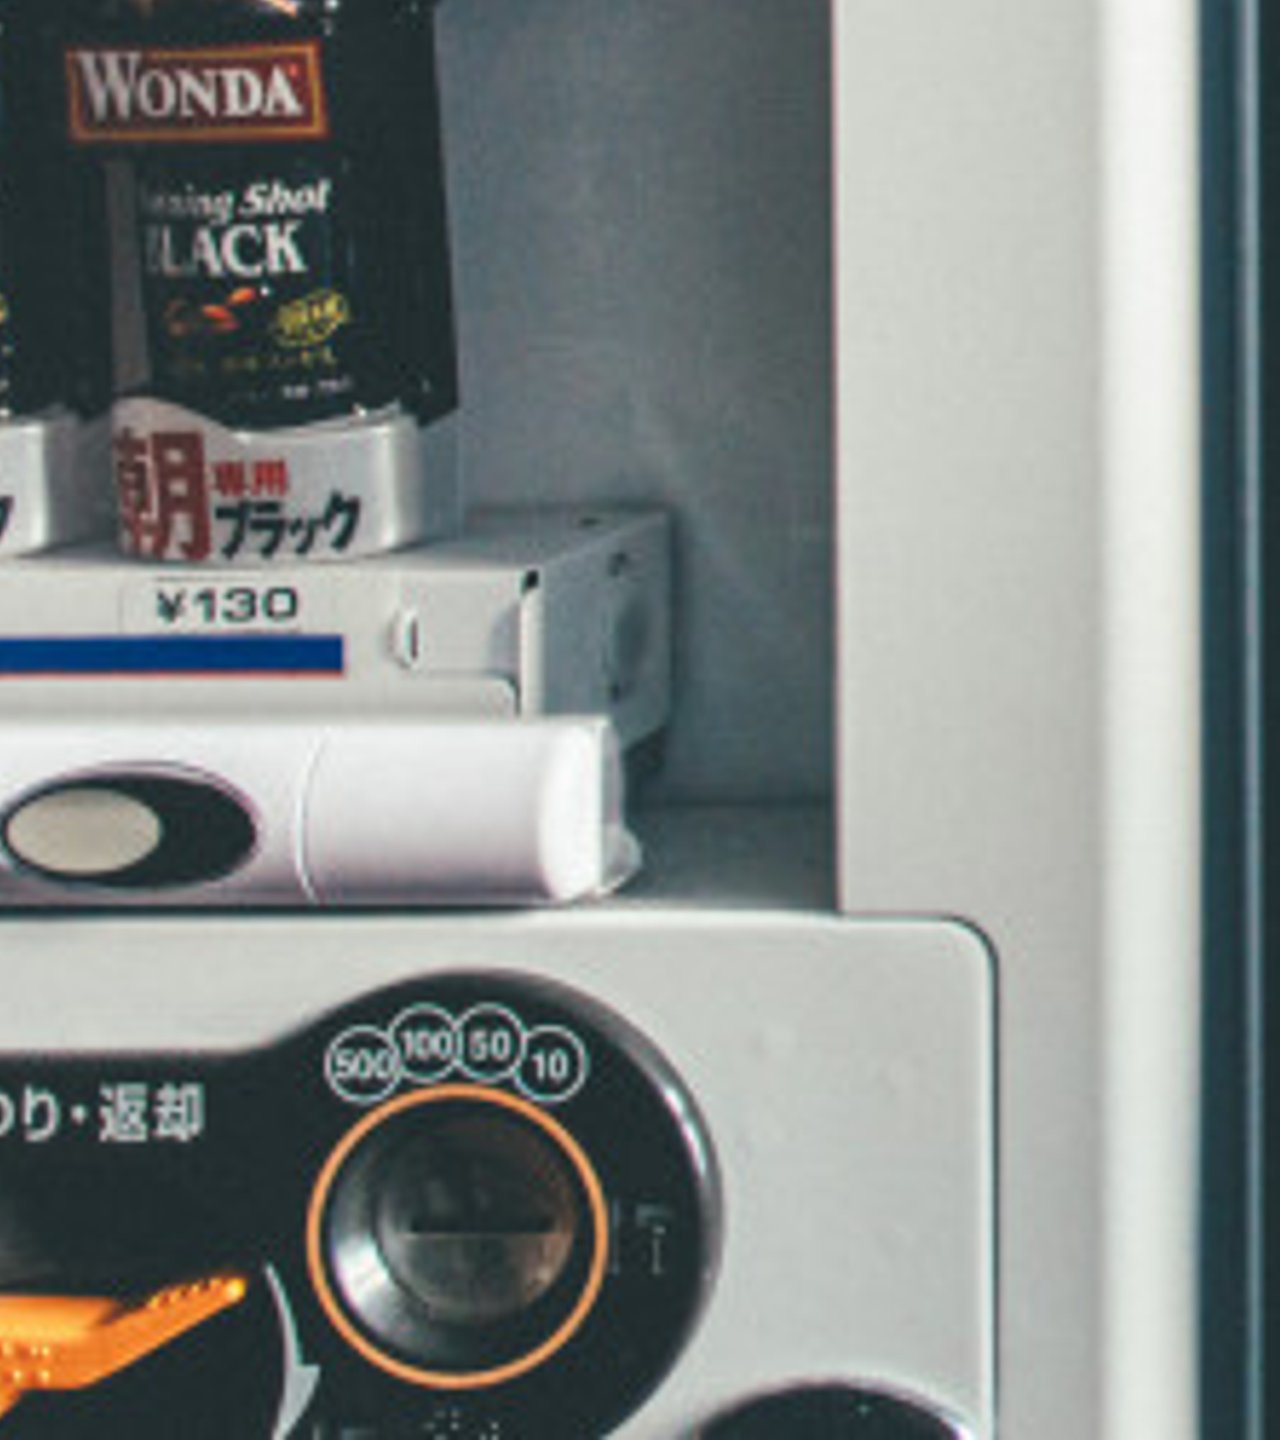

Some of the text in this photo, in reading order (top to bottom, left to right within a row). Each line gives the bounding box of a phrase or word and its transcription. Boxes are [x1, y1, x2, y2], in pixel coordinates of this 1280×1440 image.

[76, 50, 304, 122] WONDA
[238, 178, 332, 218] Shot
[110, 428, 212, 561] 朝
[214, 488, 362, 559] ブラック
[156, 586, 300, 624] ¥130
[334, 1026, 570, 1082] 500 100 50 10
